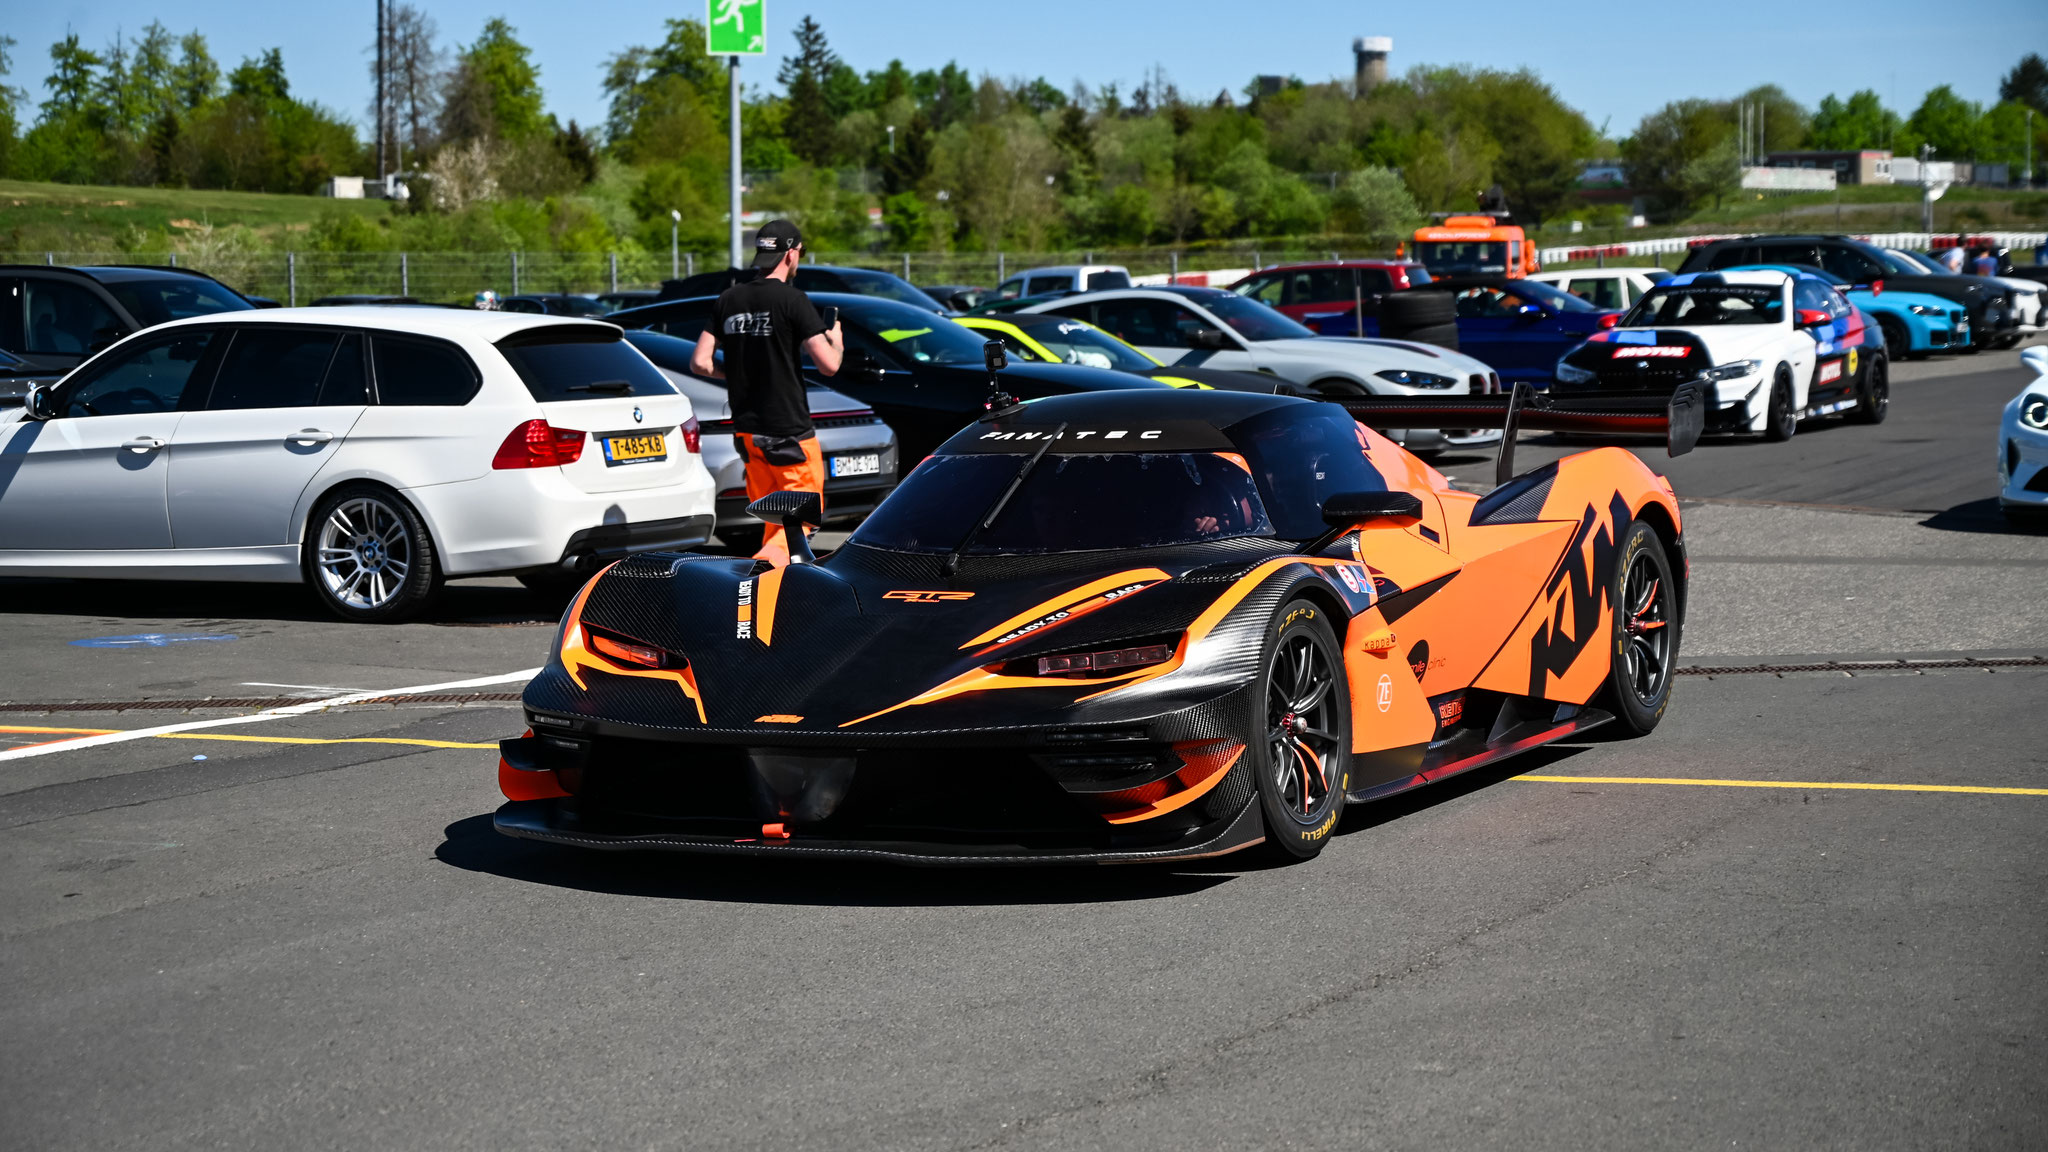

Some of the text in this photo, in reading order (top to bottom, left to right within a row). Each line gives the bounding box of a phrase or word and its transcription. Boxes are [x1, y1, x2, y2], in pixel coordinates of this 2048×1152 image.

[1617, 346, 1686, 358] MOTUL
[979, 430, 1163, 441] FANATEC
[613, 436, 662, 456] T-485-KB
[864, 454, 879, 470] 911
[737, 579, 753, 639] READY TO RACE
[997, 584, 1145, 644] READY TO RACE
[1301, 809, 1337, 841] PIRELLI
